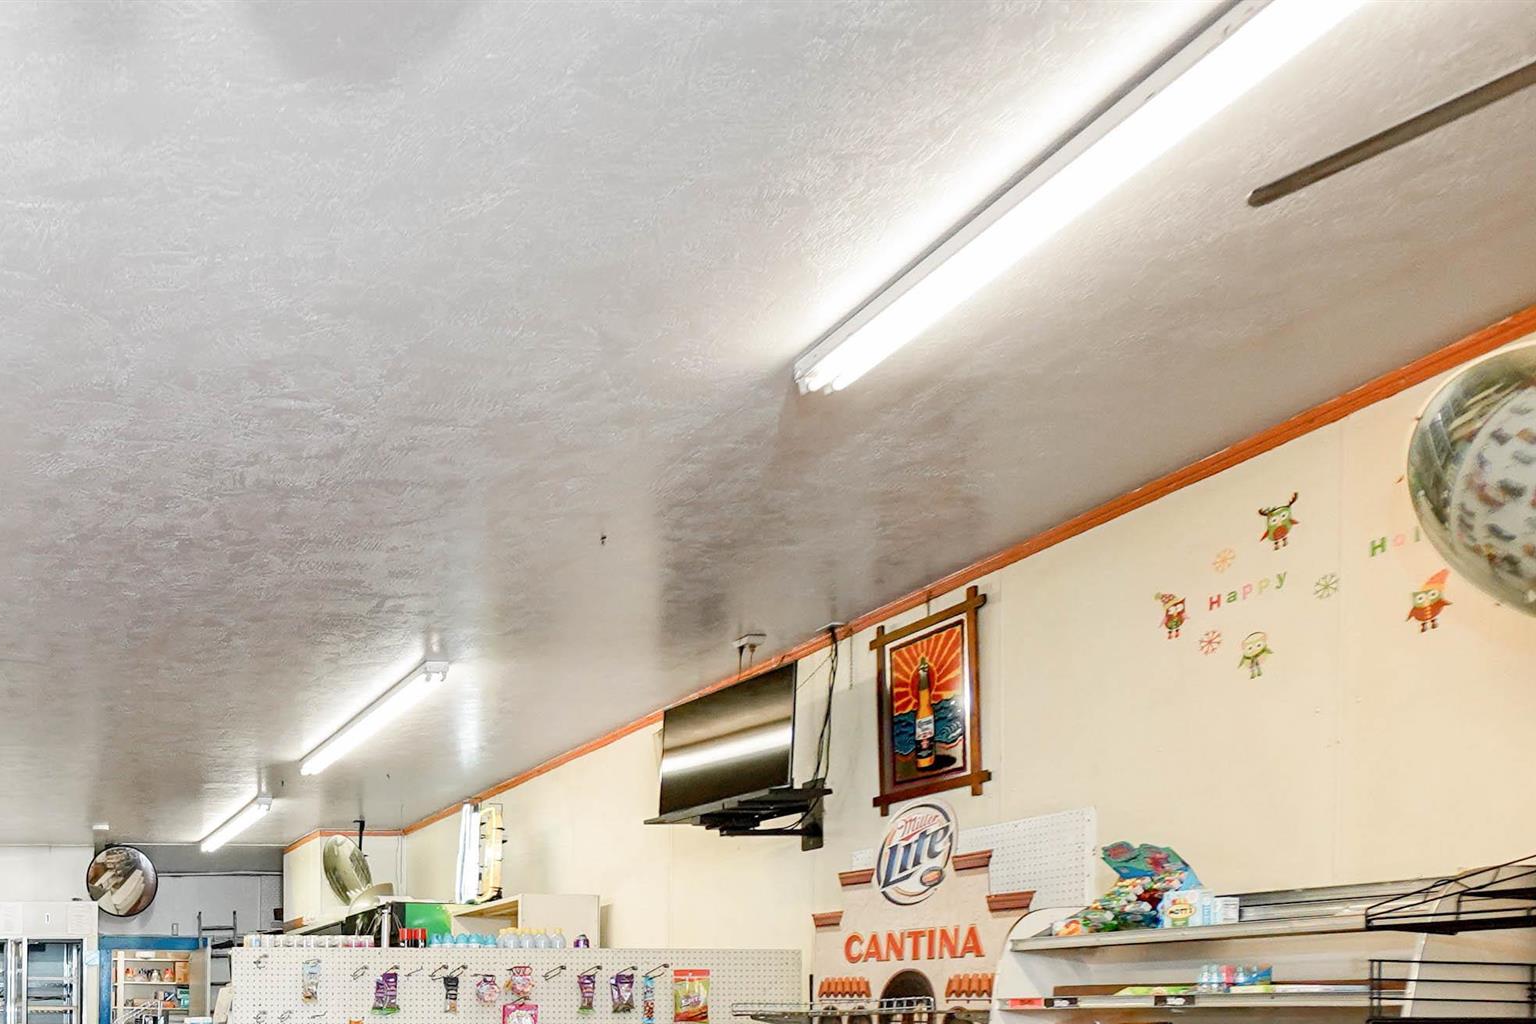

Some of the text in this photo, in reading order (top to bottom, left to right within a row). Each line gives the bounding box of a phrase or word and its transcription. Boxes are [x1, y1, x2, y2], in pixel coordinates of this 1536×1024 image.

[1208, 571, 1288, 611] Happy
[896, 814, 940, 837] Miller
[881, 824, 951, 889] Lite
[844, 924, 985, 964] CANTINA
